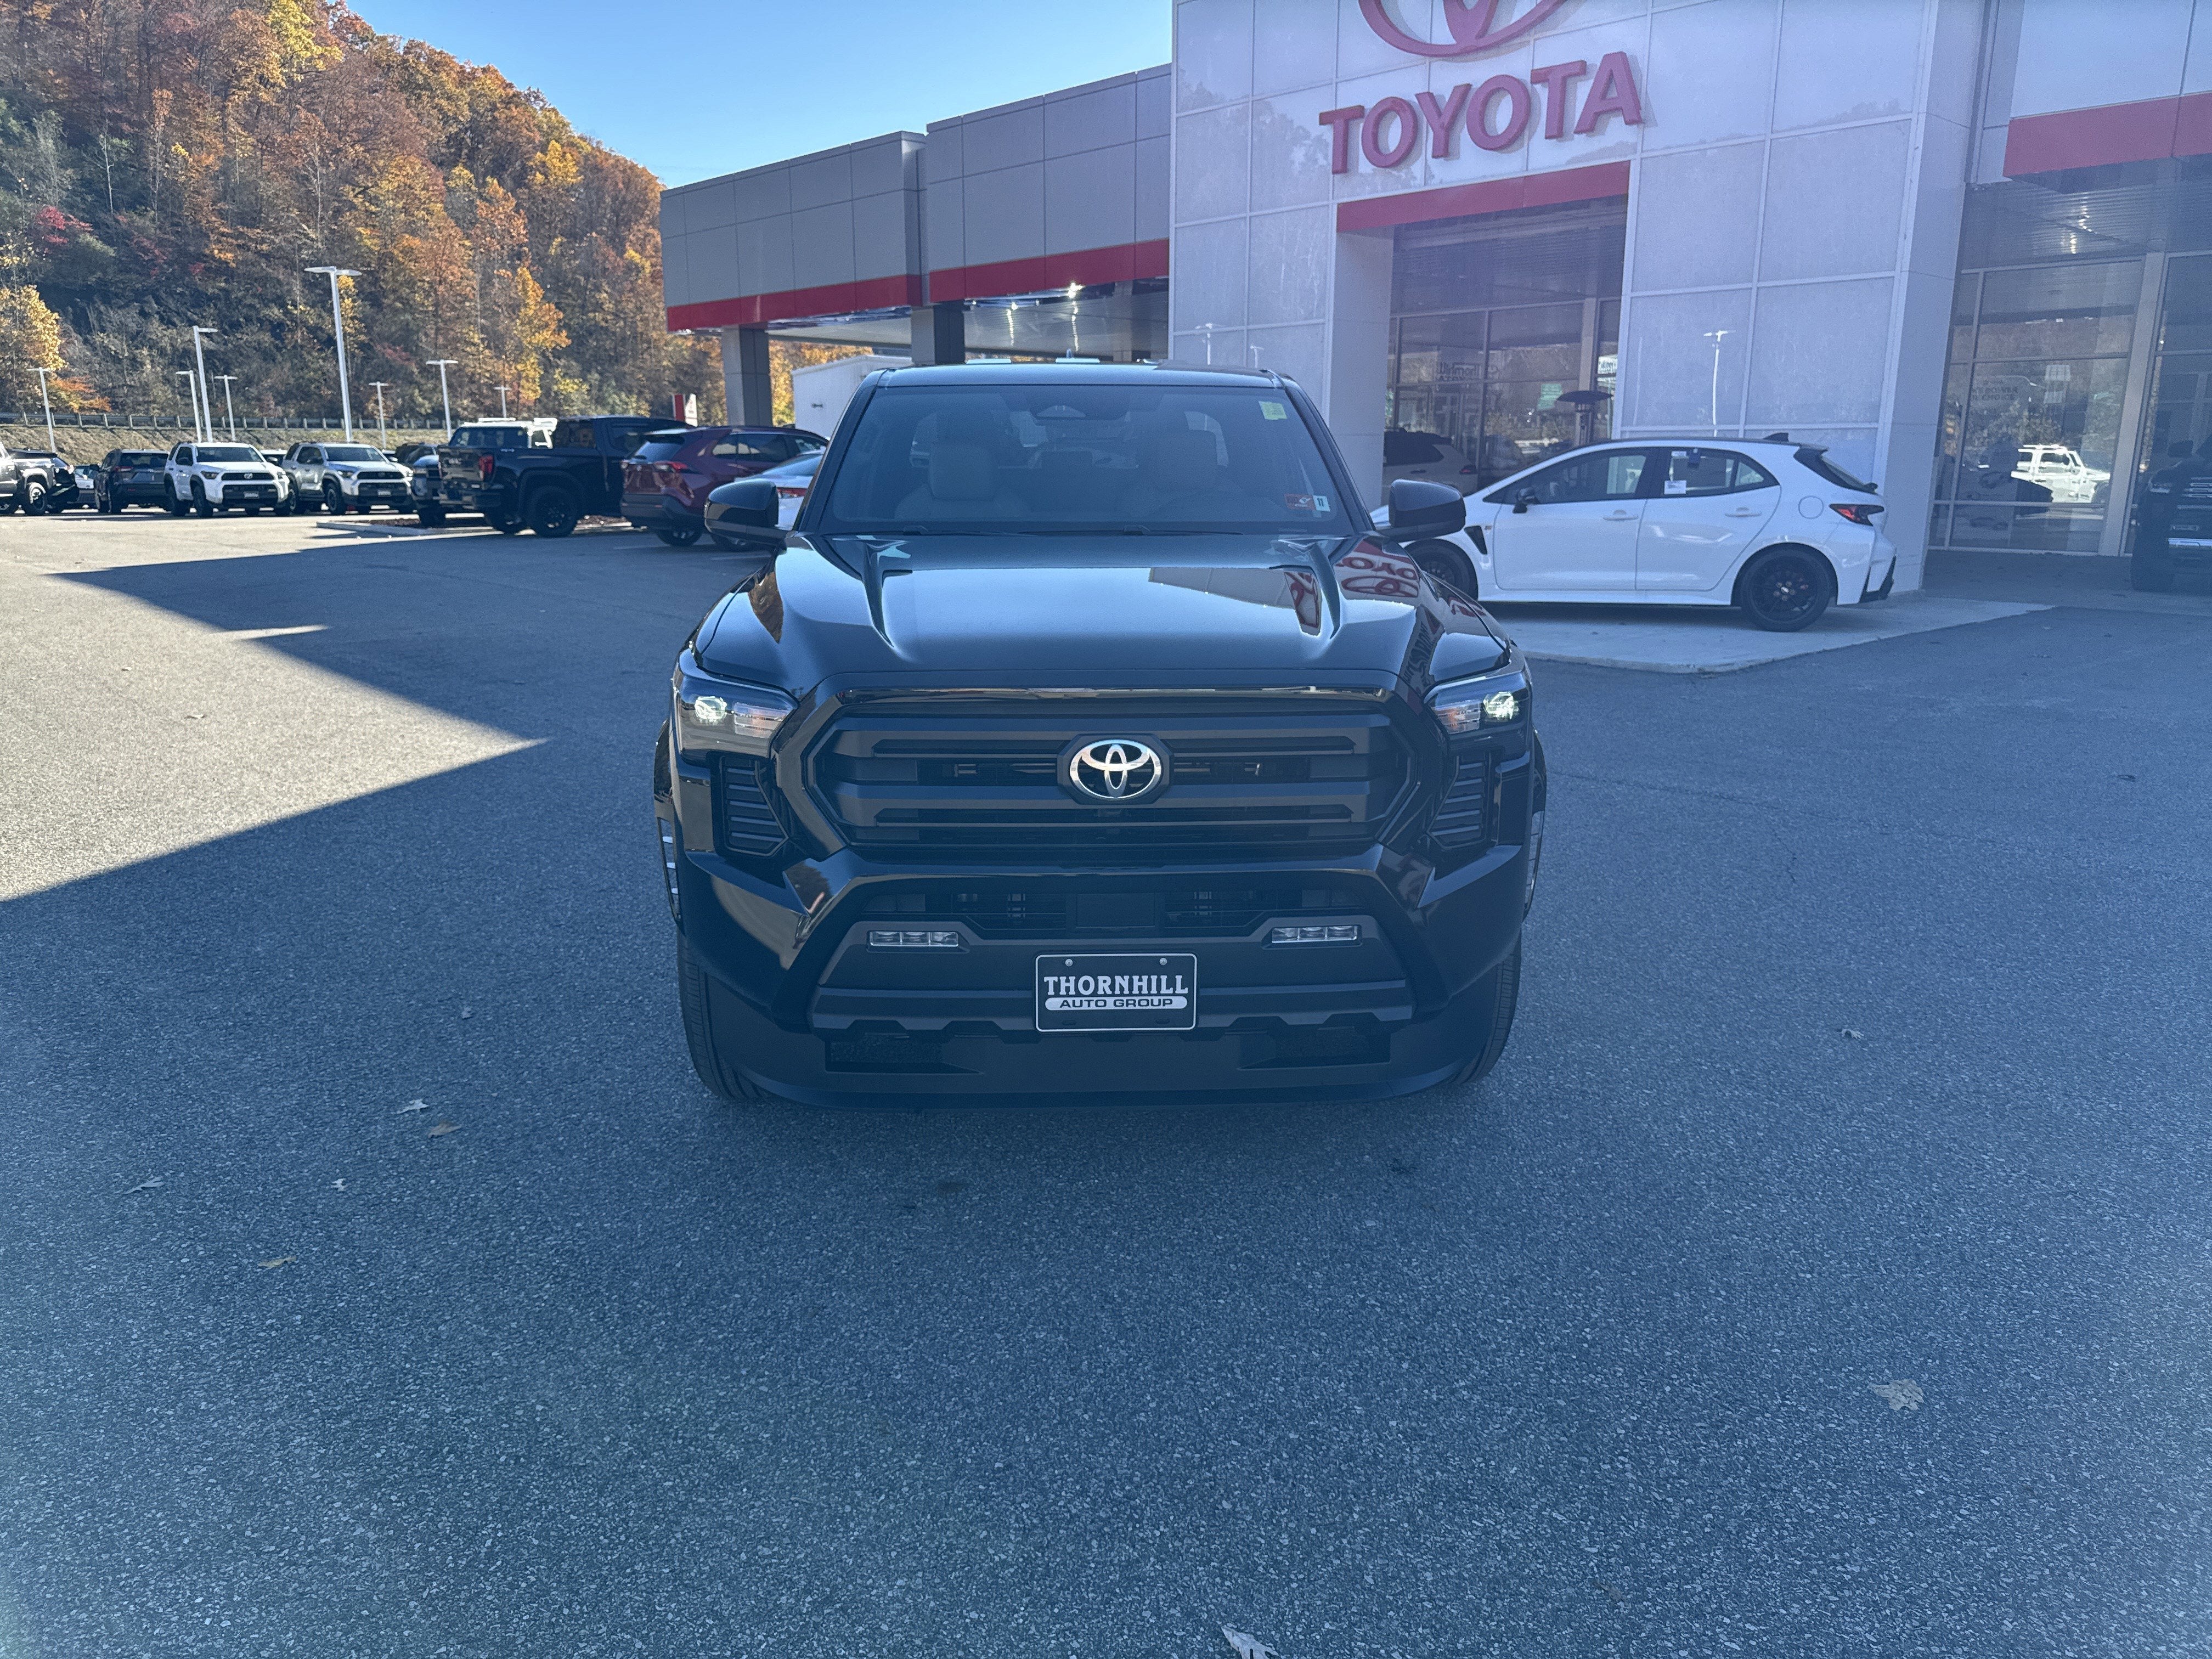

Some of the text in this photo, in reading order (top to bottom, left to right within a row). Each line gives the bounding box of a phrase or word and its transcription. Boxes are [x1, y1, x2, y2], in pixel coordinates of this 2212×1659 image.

[1319, 52, 1643, 174] TOYOTA
[1043, 975, 1188, 996] THORNHILL
[1059, 998, 1173, 1008] AUTO GROUP
